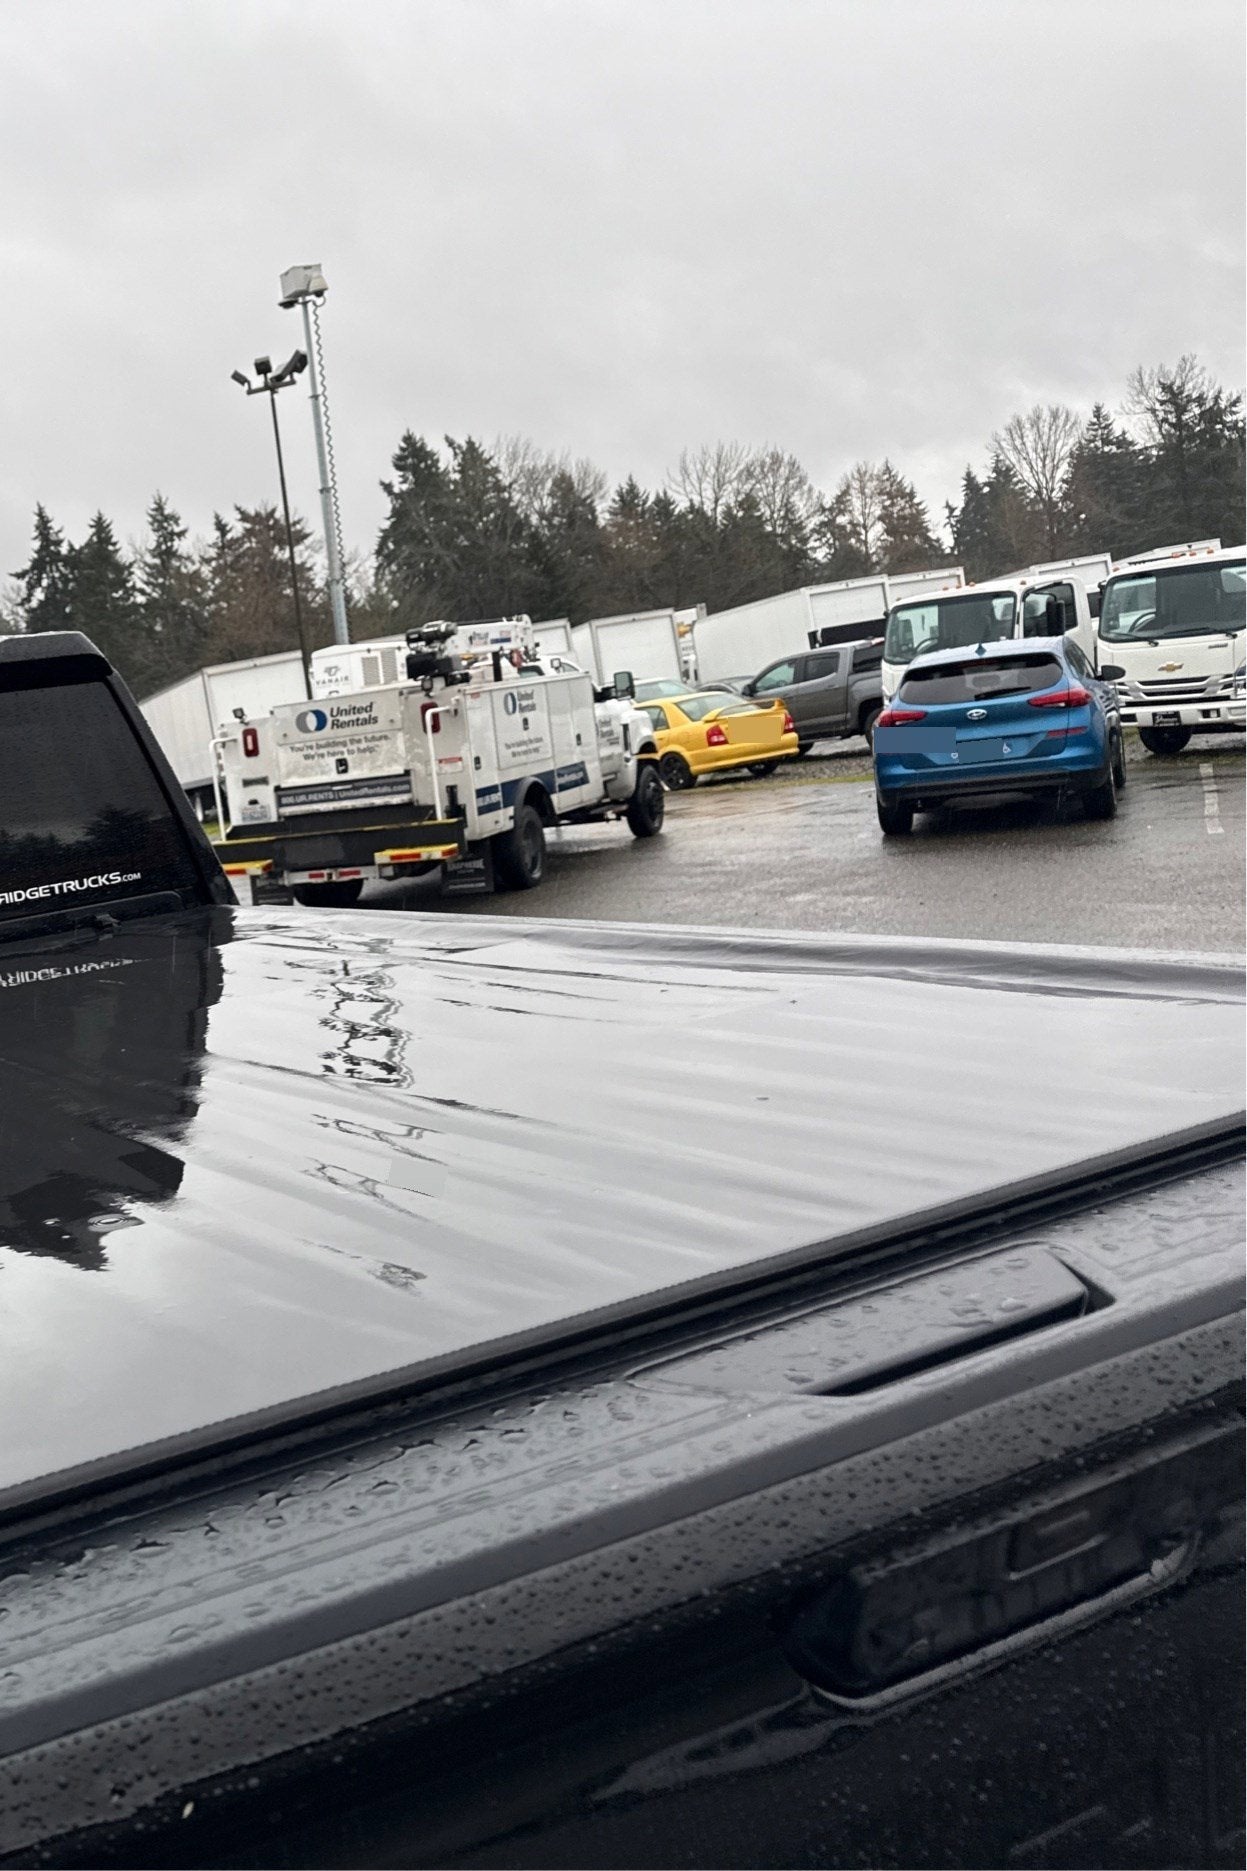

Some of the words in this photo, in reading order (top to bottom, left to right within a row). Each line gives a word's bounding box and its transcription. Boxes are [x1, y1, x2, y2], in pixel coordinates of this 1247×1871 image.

[330, 702, 374, 719] United
[331, 714, 379, 730] Rentals
[290, 743, 314, 752] You're
[316, 739, 348, 748] building
[349, 737, 362, 745] the
[303, 752, 325, 760] We're
[327, 749, 345, 757] here
[347, 746, 356, 755] to
